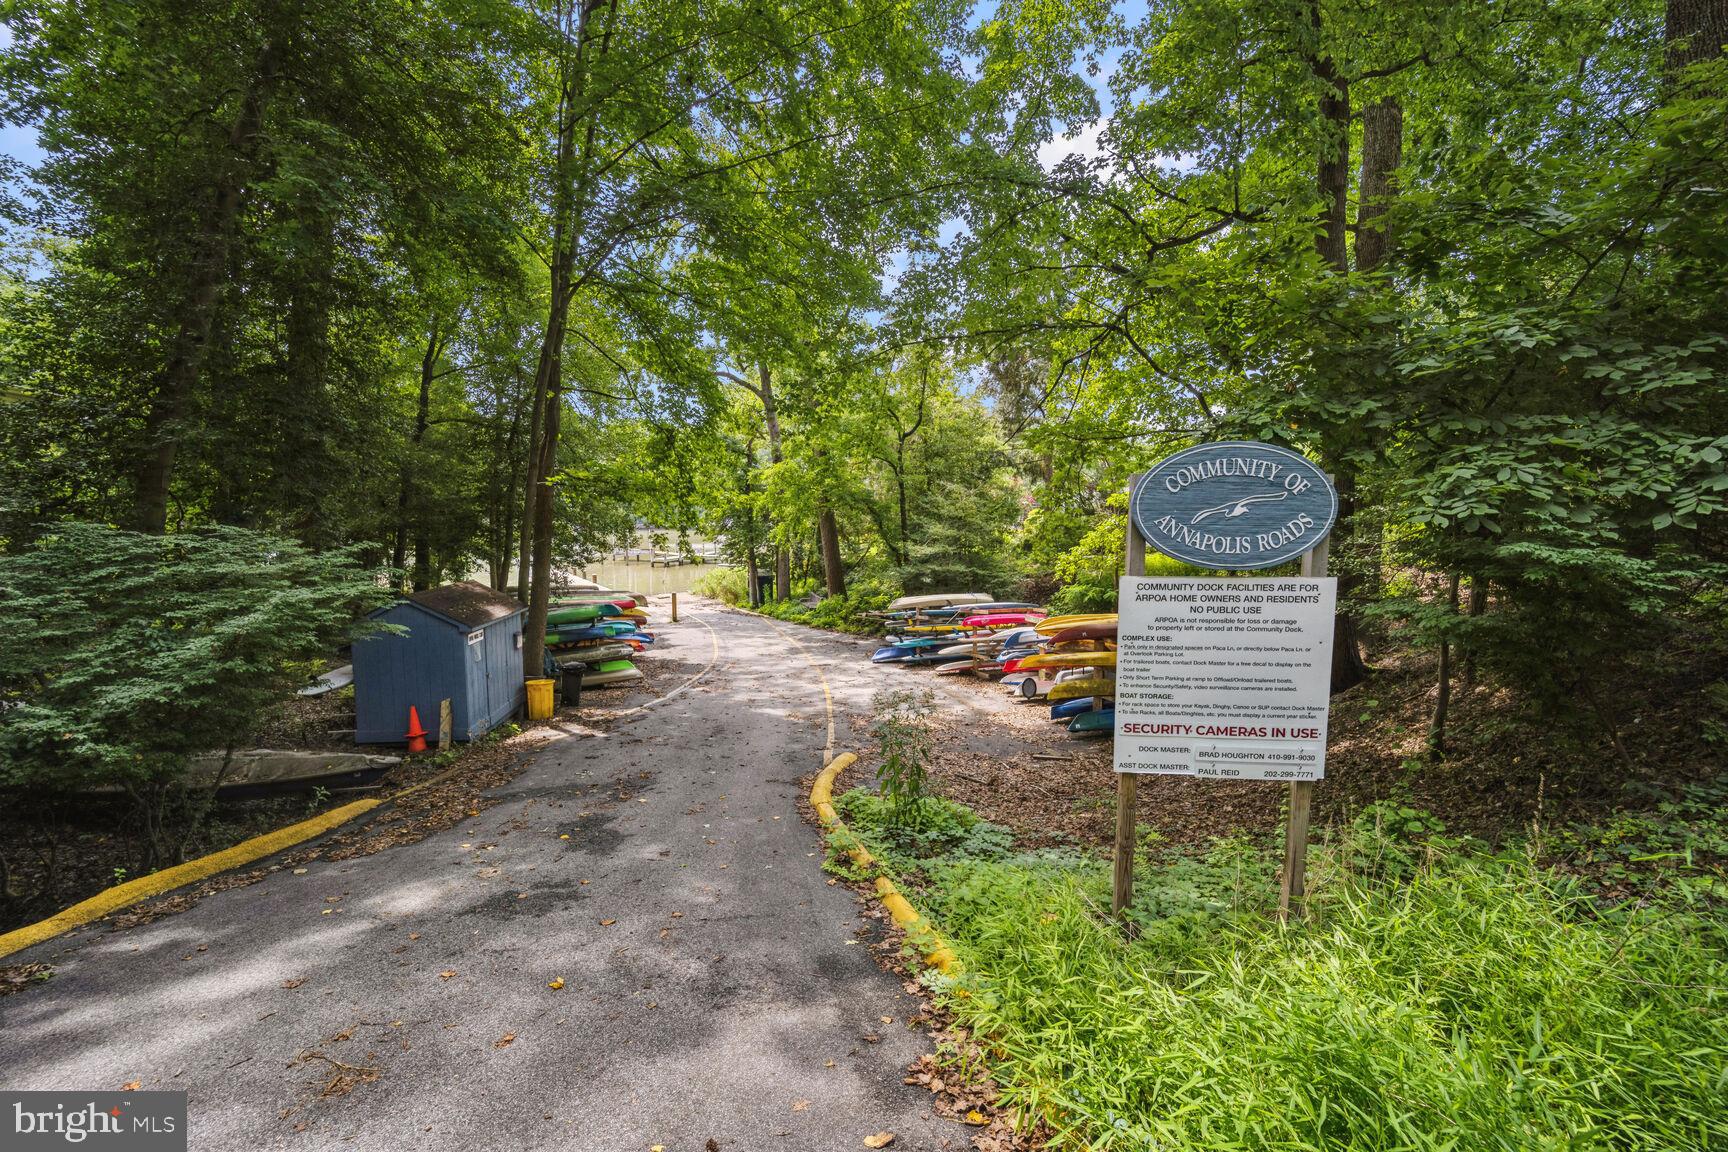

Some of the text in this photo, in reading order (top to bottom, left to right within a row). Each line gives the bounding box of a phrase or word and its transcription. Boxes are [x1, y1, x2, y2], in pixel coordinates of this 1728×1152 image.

[1165, 458, 1310, 495] COMMUNITY OF
[1154, 512, 1314, 554] ANNAPOLIS ROADS
[1124, 723, 1318, 738] SECURITY CAMERAS IN USE
